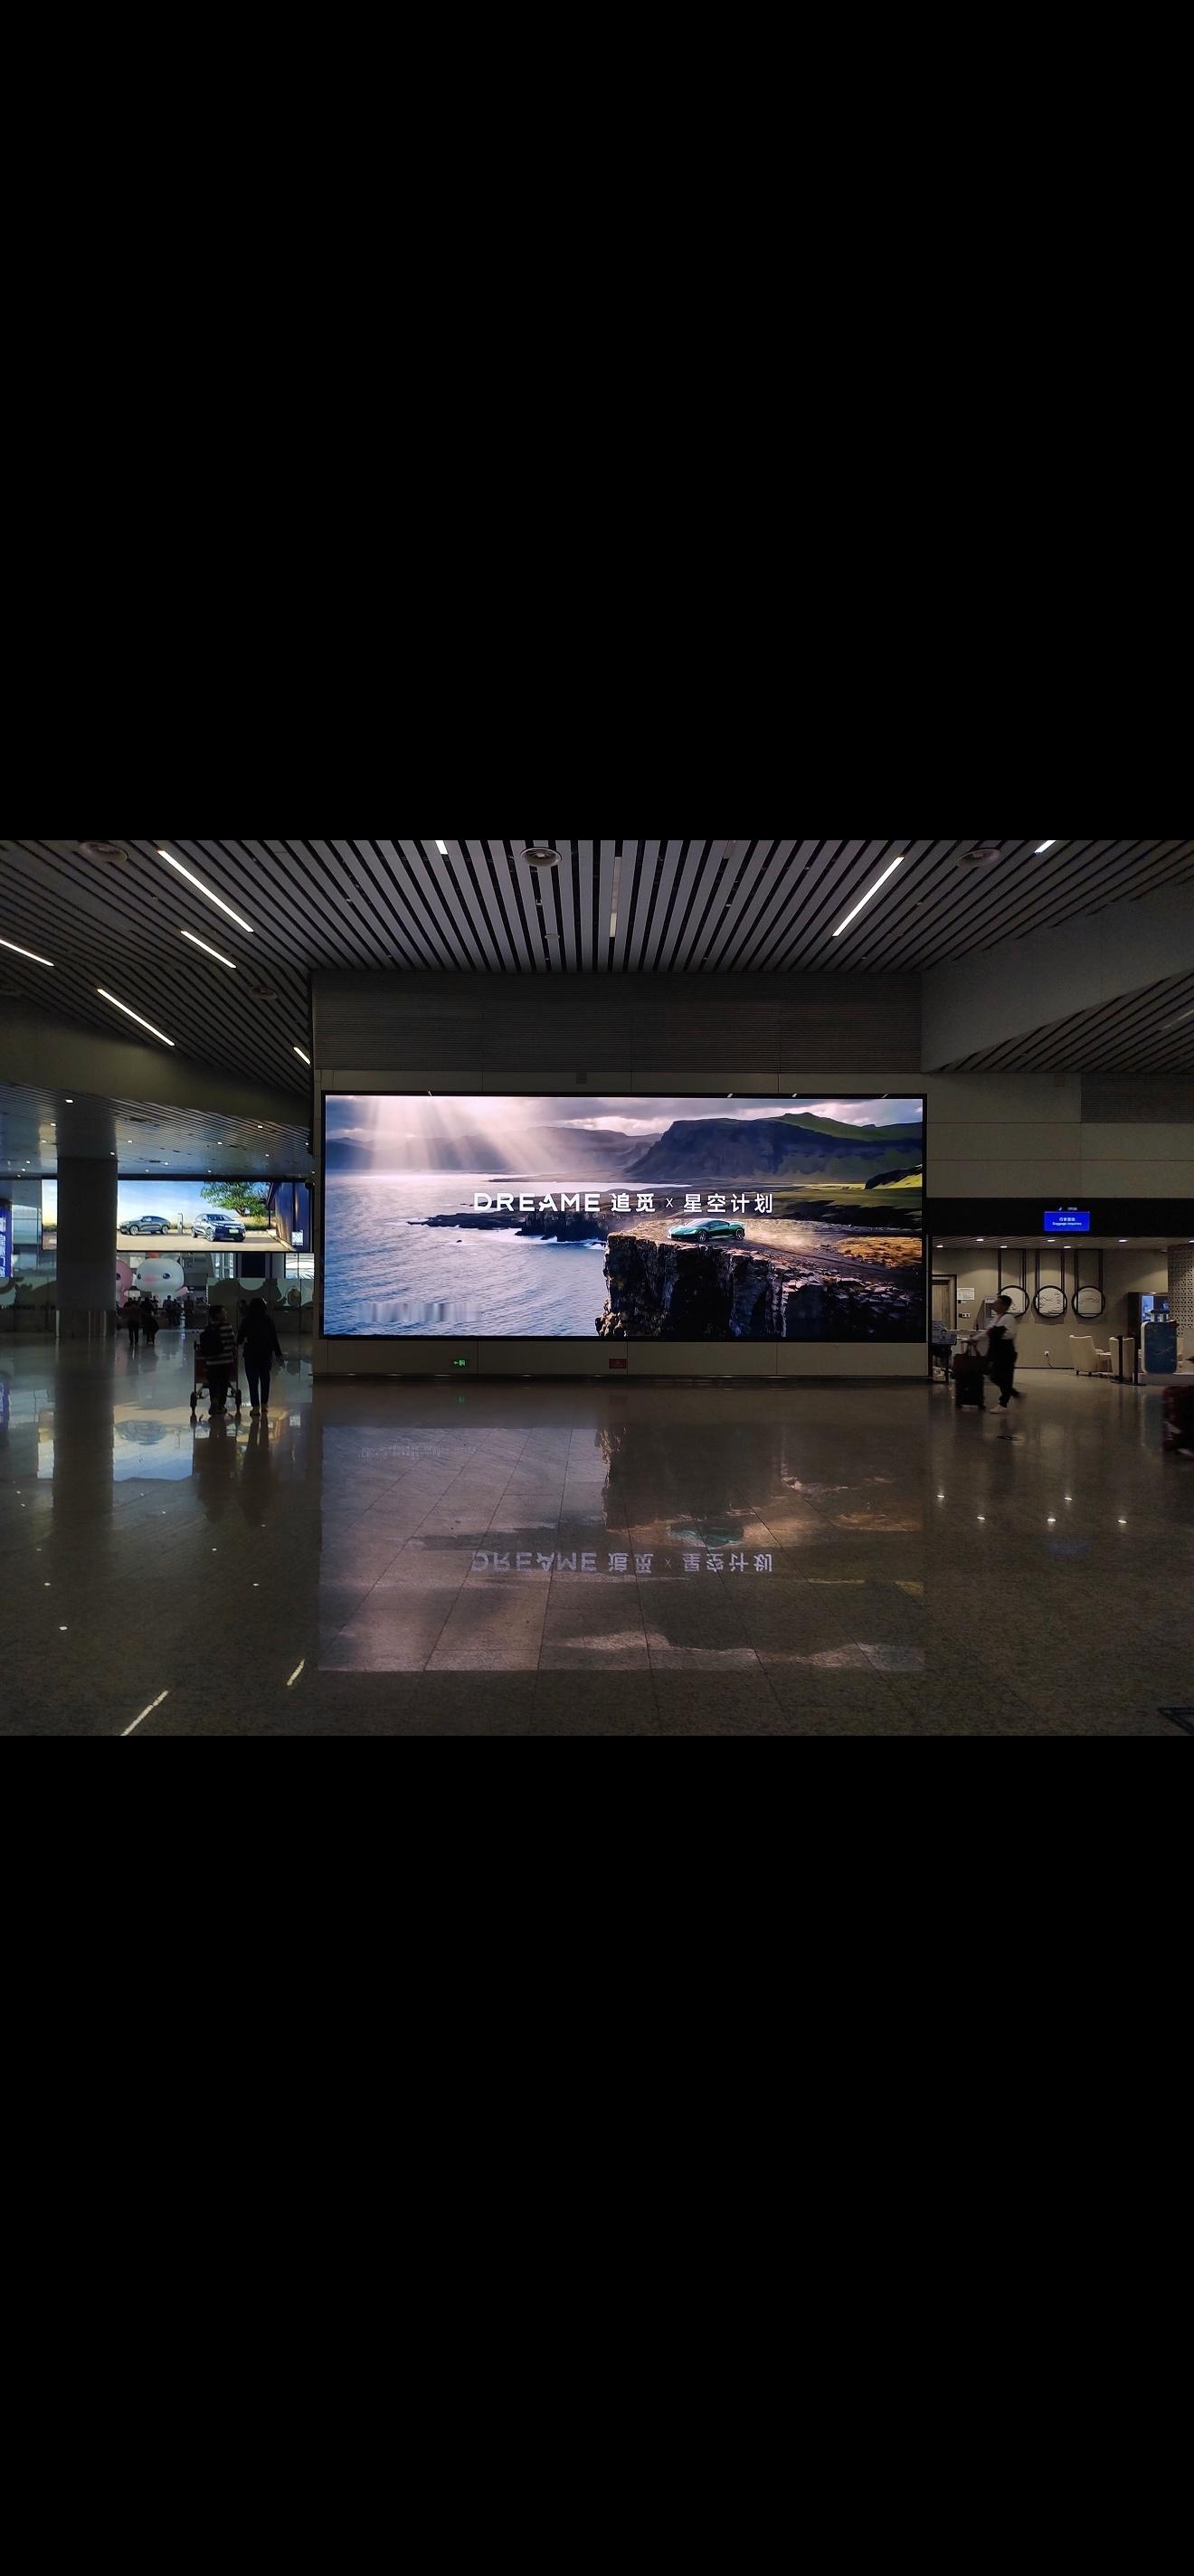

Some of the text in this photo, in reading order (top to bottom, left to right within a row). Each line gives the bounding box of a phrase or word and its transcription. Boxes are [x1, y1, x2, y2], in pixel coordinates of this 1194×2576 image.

[473, 1192, 601, 1212] DREAME
[611, 1192, 656, 1213] 追觅
[683, 1193, 773, 1214] 星空计划
